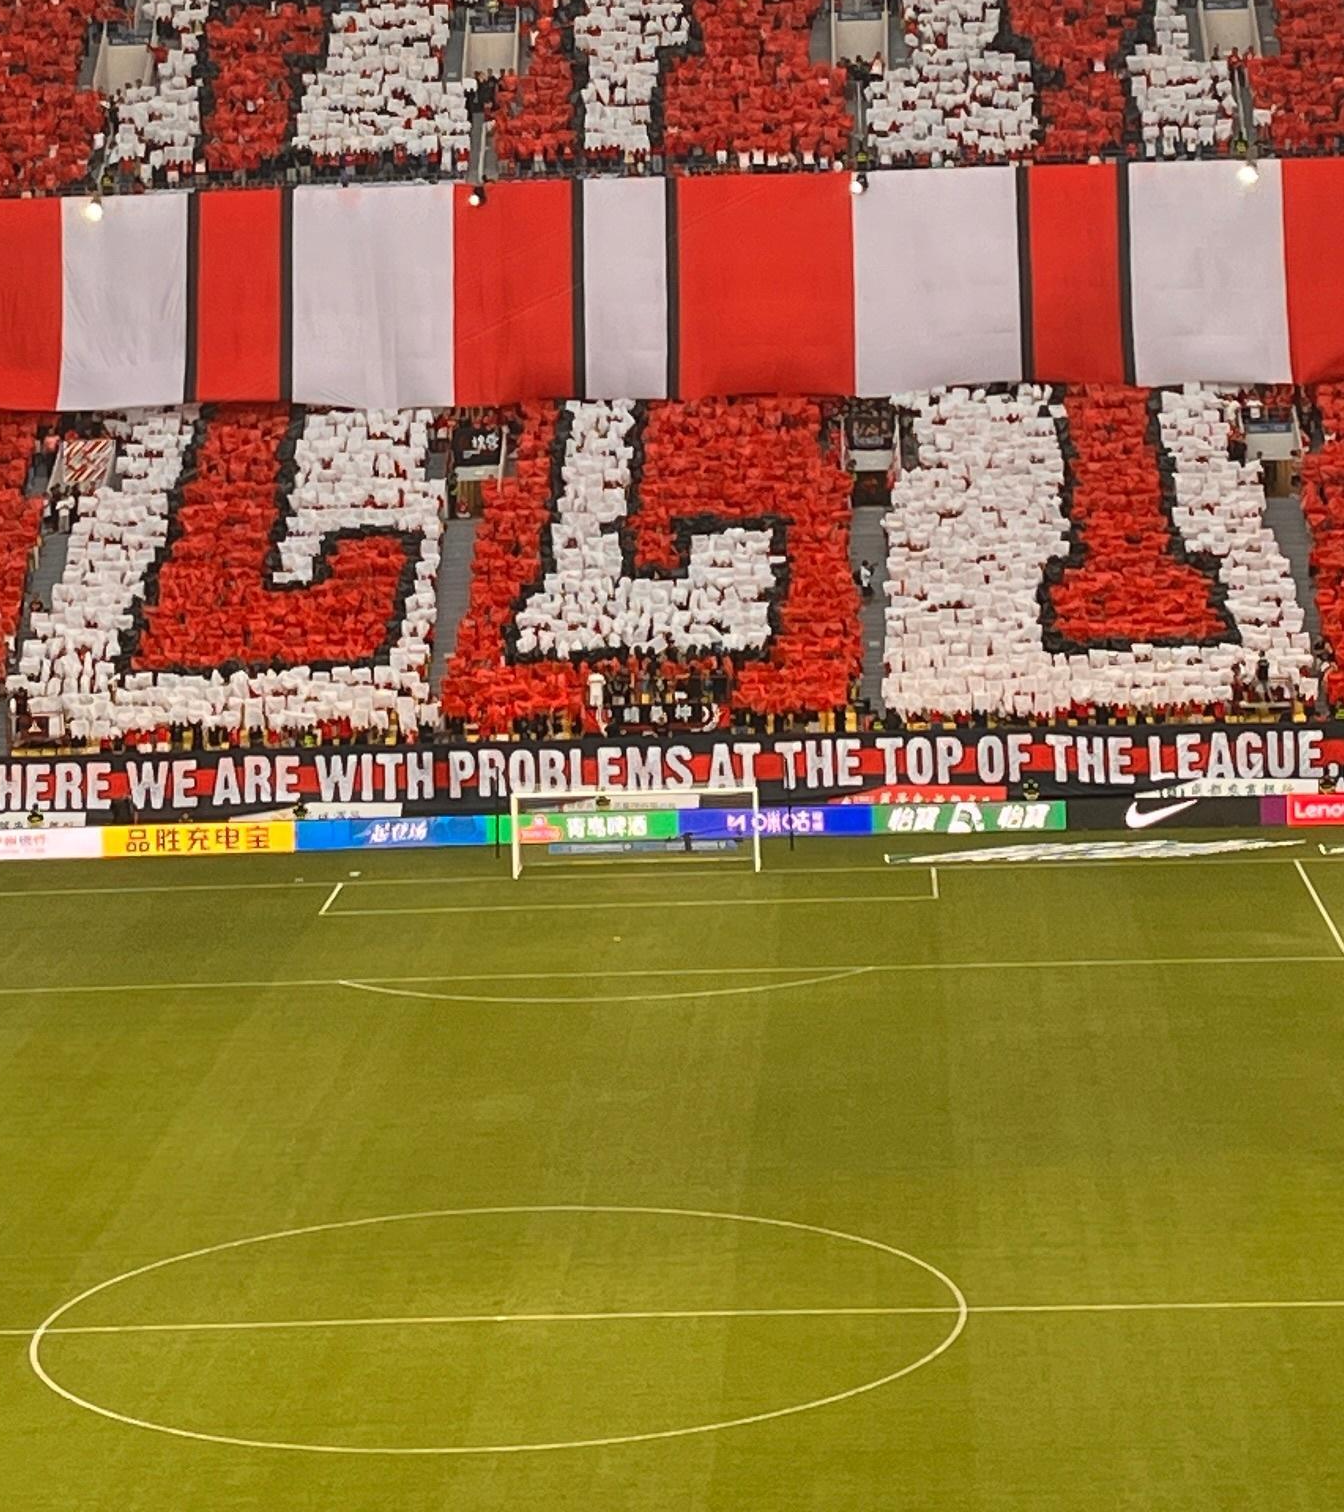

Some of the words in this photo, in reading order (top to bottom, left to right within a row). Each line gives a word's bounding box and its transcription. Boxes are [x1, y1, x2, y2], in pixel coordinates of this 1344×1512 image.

[126, 759, 198, 810] WE
[212, 755, 301, 806] ARE
[315, 751, 434, 803] WITH
[448, 746, 694, 799] PROBLEMS
[708, 742, 761, 790] AT
[775, 737, 862, 789] THE
[876, 736, 962, 785] TOP
[977, 733, 1032, 785] OF
[1045, 734, 1135, 786] THE
[126, 826, 270, 852] 品胜充电宝
